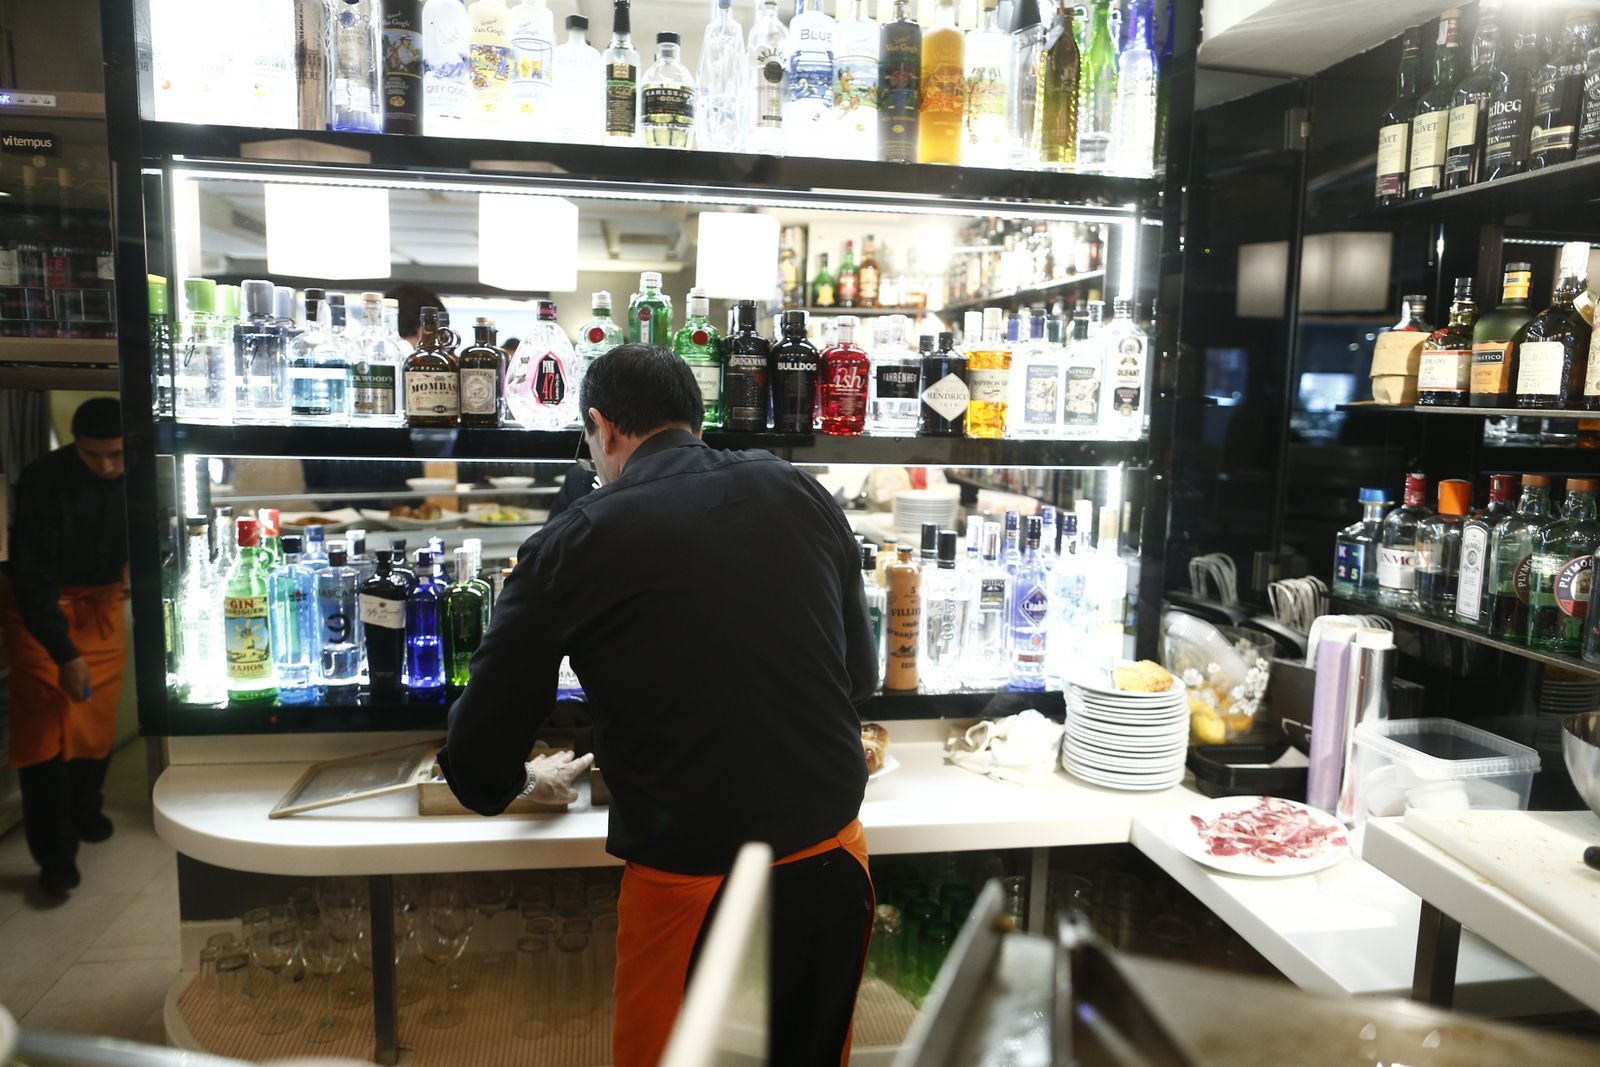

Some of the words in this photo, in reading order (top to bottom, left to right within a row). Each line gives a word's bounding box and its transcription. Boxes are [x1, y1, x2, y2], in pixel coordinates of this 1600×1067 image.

[800, 28, 833, 43] BLUE
[777, 362, 817, 371] BULLDOG
[229, 600, 254, 609] GIN
[327, 613, 351, 644] 9
